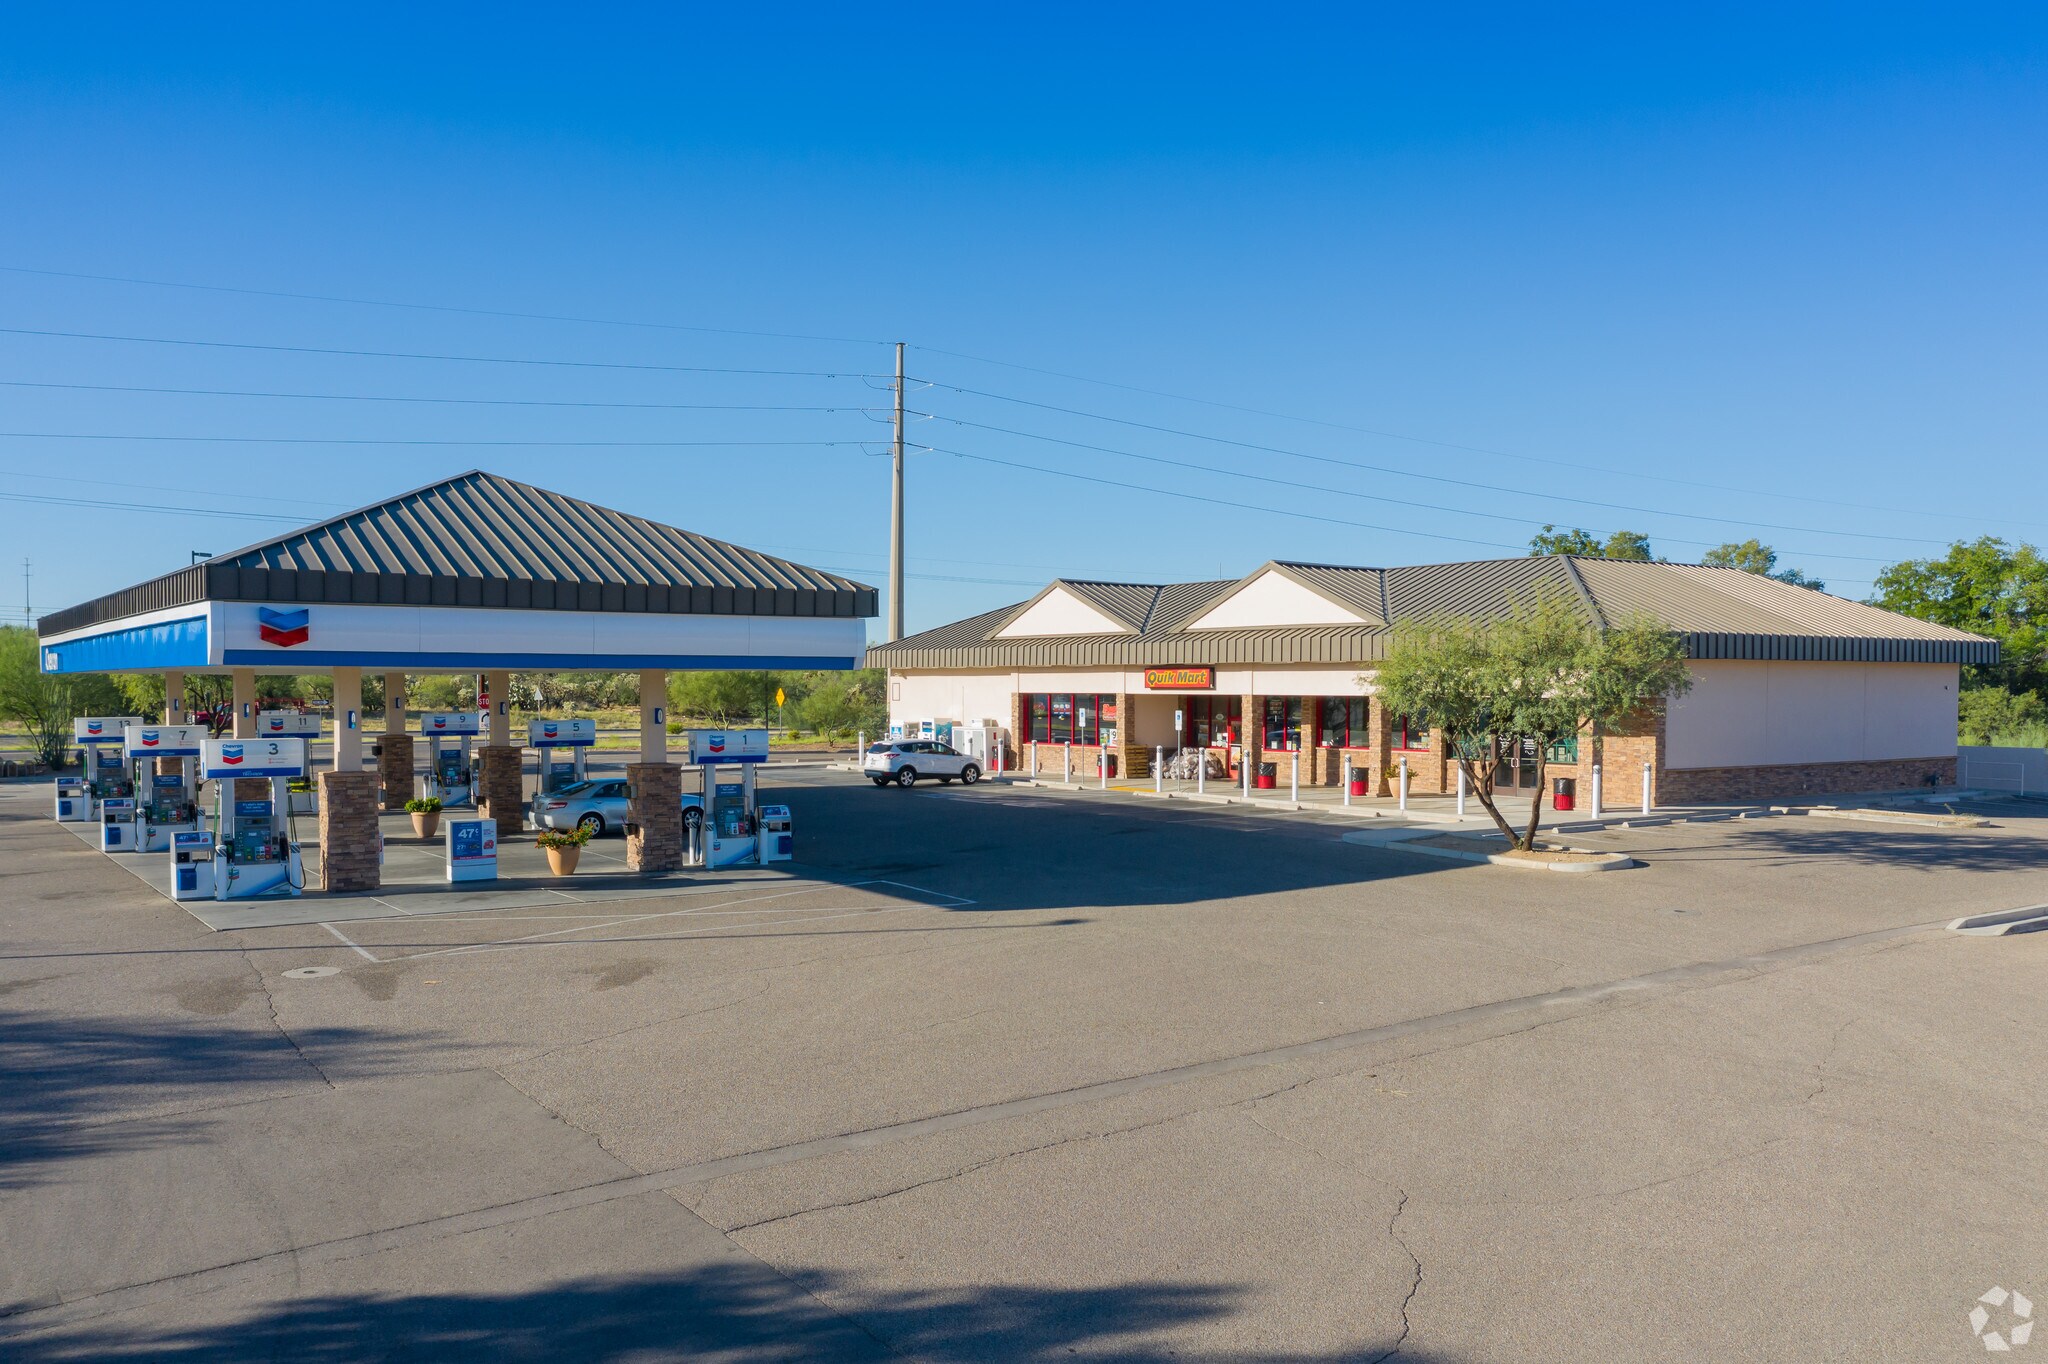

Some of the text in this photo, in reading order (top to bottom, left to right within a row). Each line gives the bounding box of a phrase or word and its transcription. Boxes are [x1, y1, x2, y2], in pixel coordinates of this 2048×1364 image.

[1147, 669, 1207, 686] Quik Mart
[298, 717, 307, 725] 11
[460, 715, 466, 723] 9
[573, 722, 580, 732] 5
[179, 730, 187, 740] 7
[742, 734, 747, 744] 1
[268, 742, 278, 755] 3
